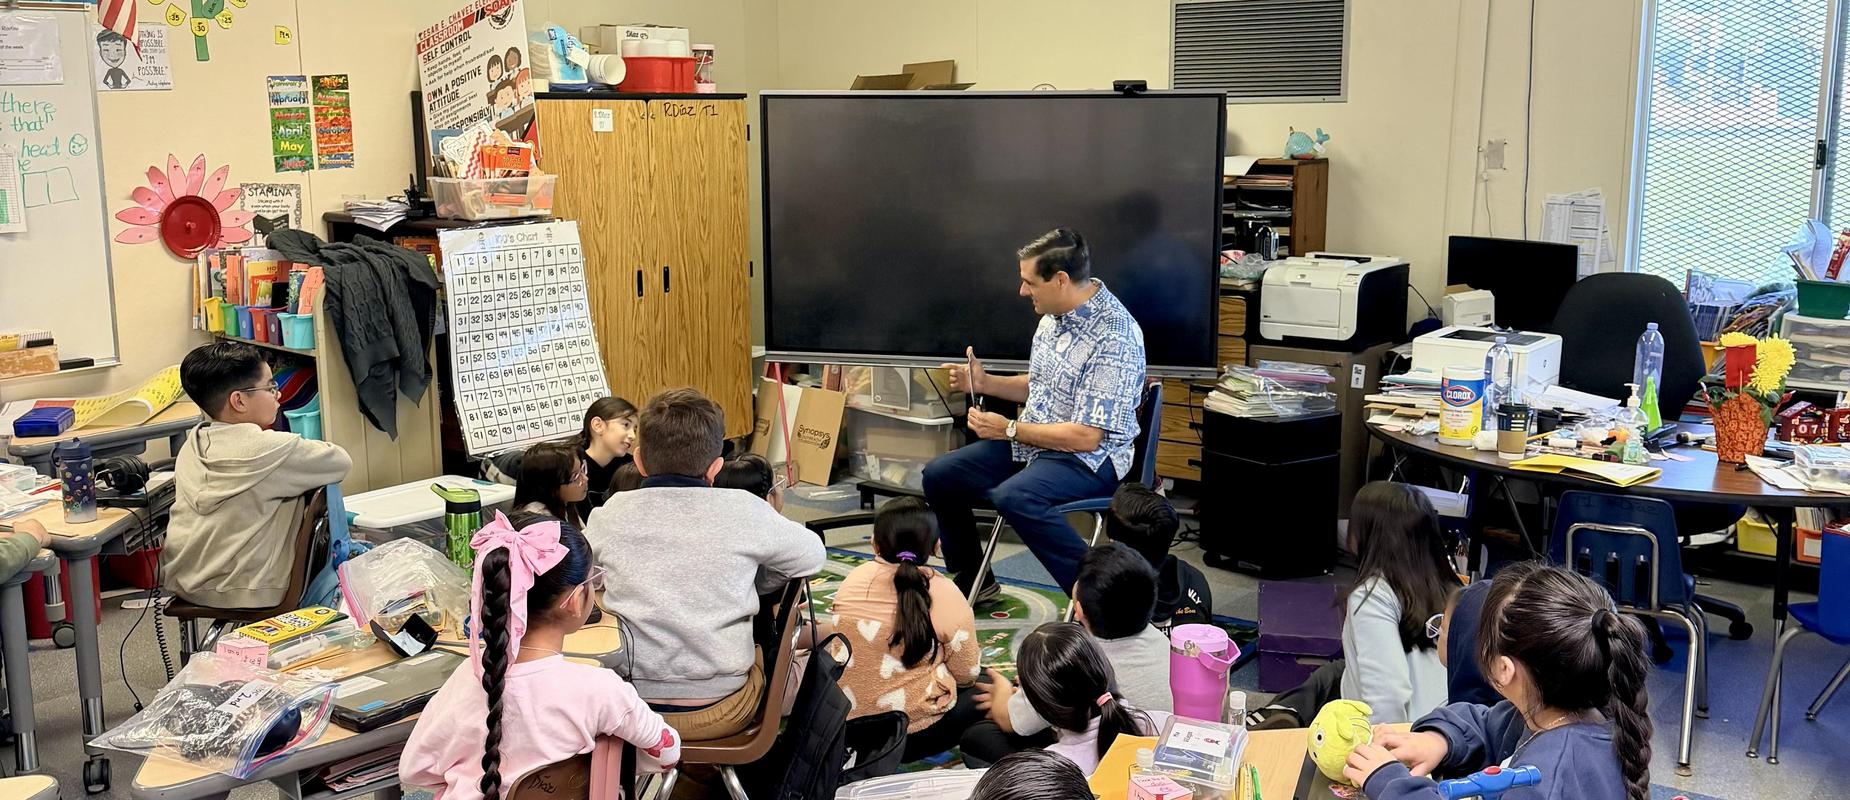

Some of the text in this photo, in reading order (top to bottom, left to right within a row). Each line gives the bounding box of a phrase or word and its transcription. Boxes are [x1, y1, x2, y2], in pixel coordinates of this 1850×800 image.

[448, 4, 473, 24] CHAVEZ
[420, 20, 464, 52] CLASSROOM
[422, 30, 472, 62] SELF CONTROL
[427, 66, 482, 102] OWN A POSITIVE
[0, 91, 56, 114] there
[430, 88, 460, 113] ATTITUDE
[702, 104, 718, 116] T1
[279, 125, 302, 138] April
[280, 140, 304, 154] May
[248, 186, 292, 198] STAMINA
[516, 232, 538, 242] Chart
[468, 257, 475, 266] 2
[482, 256, 488, 264] 3
[509, 253, 514, 262] 5
[522, 252, 527, 260] 6
[534, 251, 539, 259] 7
[547, 249, 552, 258] 8
[571, 247, 578, 255] 10
[458, 266, 579, 287] 11 12 13 14 15 16 17 18 19 20
[457, 284, 582, 306] 21 22 23 24 25 26 27 28 29 30
[458, 303, 584, 326] 31 32 33 34 35 36 37 38 39 40
[459, 336, 467, 344] 41
[472, 334, 481, 343] 42
[485, 332, 494, 341] 43
[512, 329, 521, 337] 45
[565, 322, 574, 330] 49
[577, 320, 587, 329] 50
[460, 355, 469, 365] 51
[473, 353, 482, 363] 52
[486, 352, 497, 360] 53
[541, 344, 550, 353] 57
[554, 342, 564, 351] 58
[568, 340, 577, 349] 59
[581, 338, 590, 347] 60
[461, 374, 471, 384] 61
[475, 373, 485, 382] 62
[489, 371, 499, 380] 63
[503, 369, 513, 377] 64
[517, 367, 527, 375] 65
[531, 364, 541, 373] 66
[545, 362, 554, 371] 67
[558, 361, 568, 369] 68
[571, 358, 581, 367] 69
[463, 374, 599, 402] 71 72 73 74 75 76 77 78 79 80
[1446, 390, 1472, 400] CLOROX
[469, 412, 479, 421] 81
[483, 410, 493, 419] 82
[497, 408, 508, 417] 83
[512, 405, 522, 414] 84
[526, 403, 536, 412] 85
[539, 401, 550, 409] 86
[553, 398, 562, 407] 87
[567, 396, 577, 404] 88
[580, 393, 590, 402] 89
[1090, 398, 1106, 425] LA
[473, 414, 581, 439] 91 92 93 94 95 96 97 98
[799, 424, 830, 439] Synopsys
[230, 692, 252, 708] 2nd
